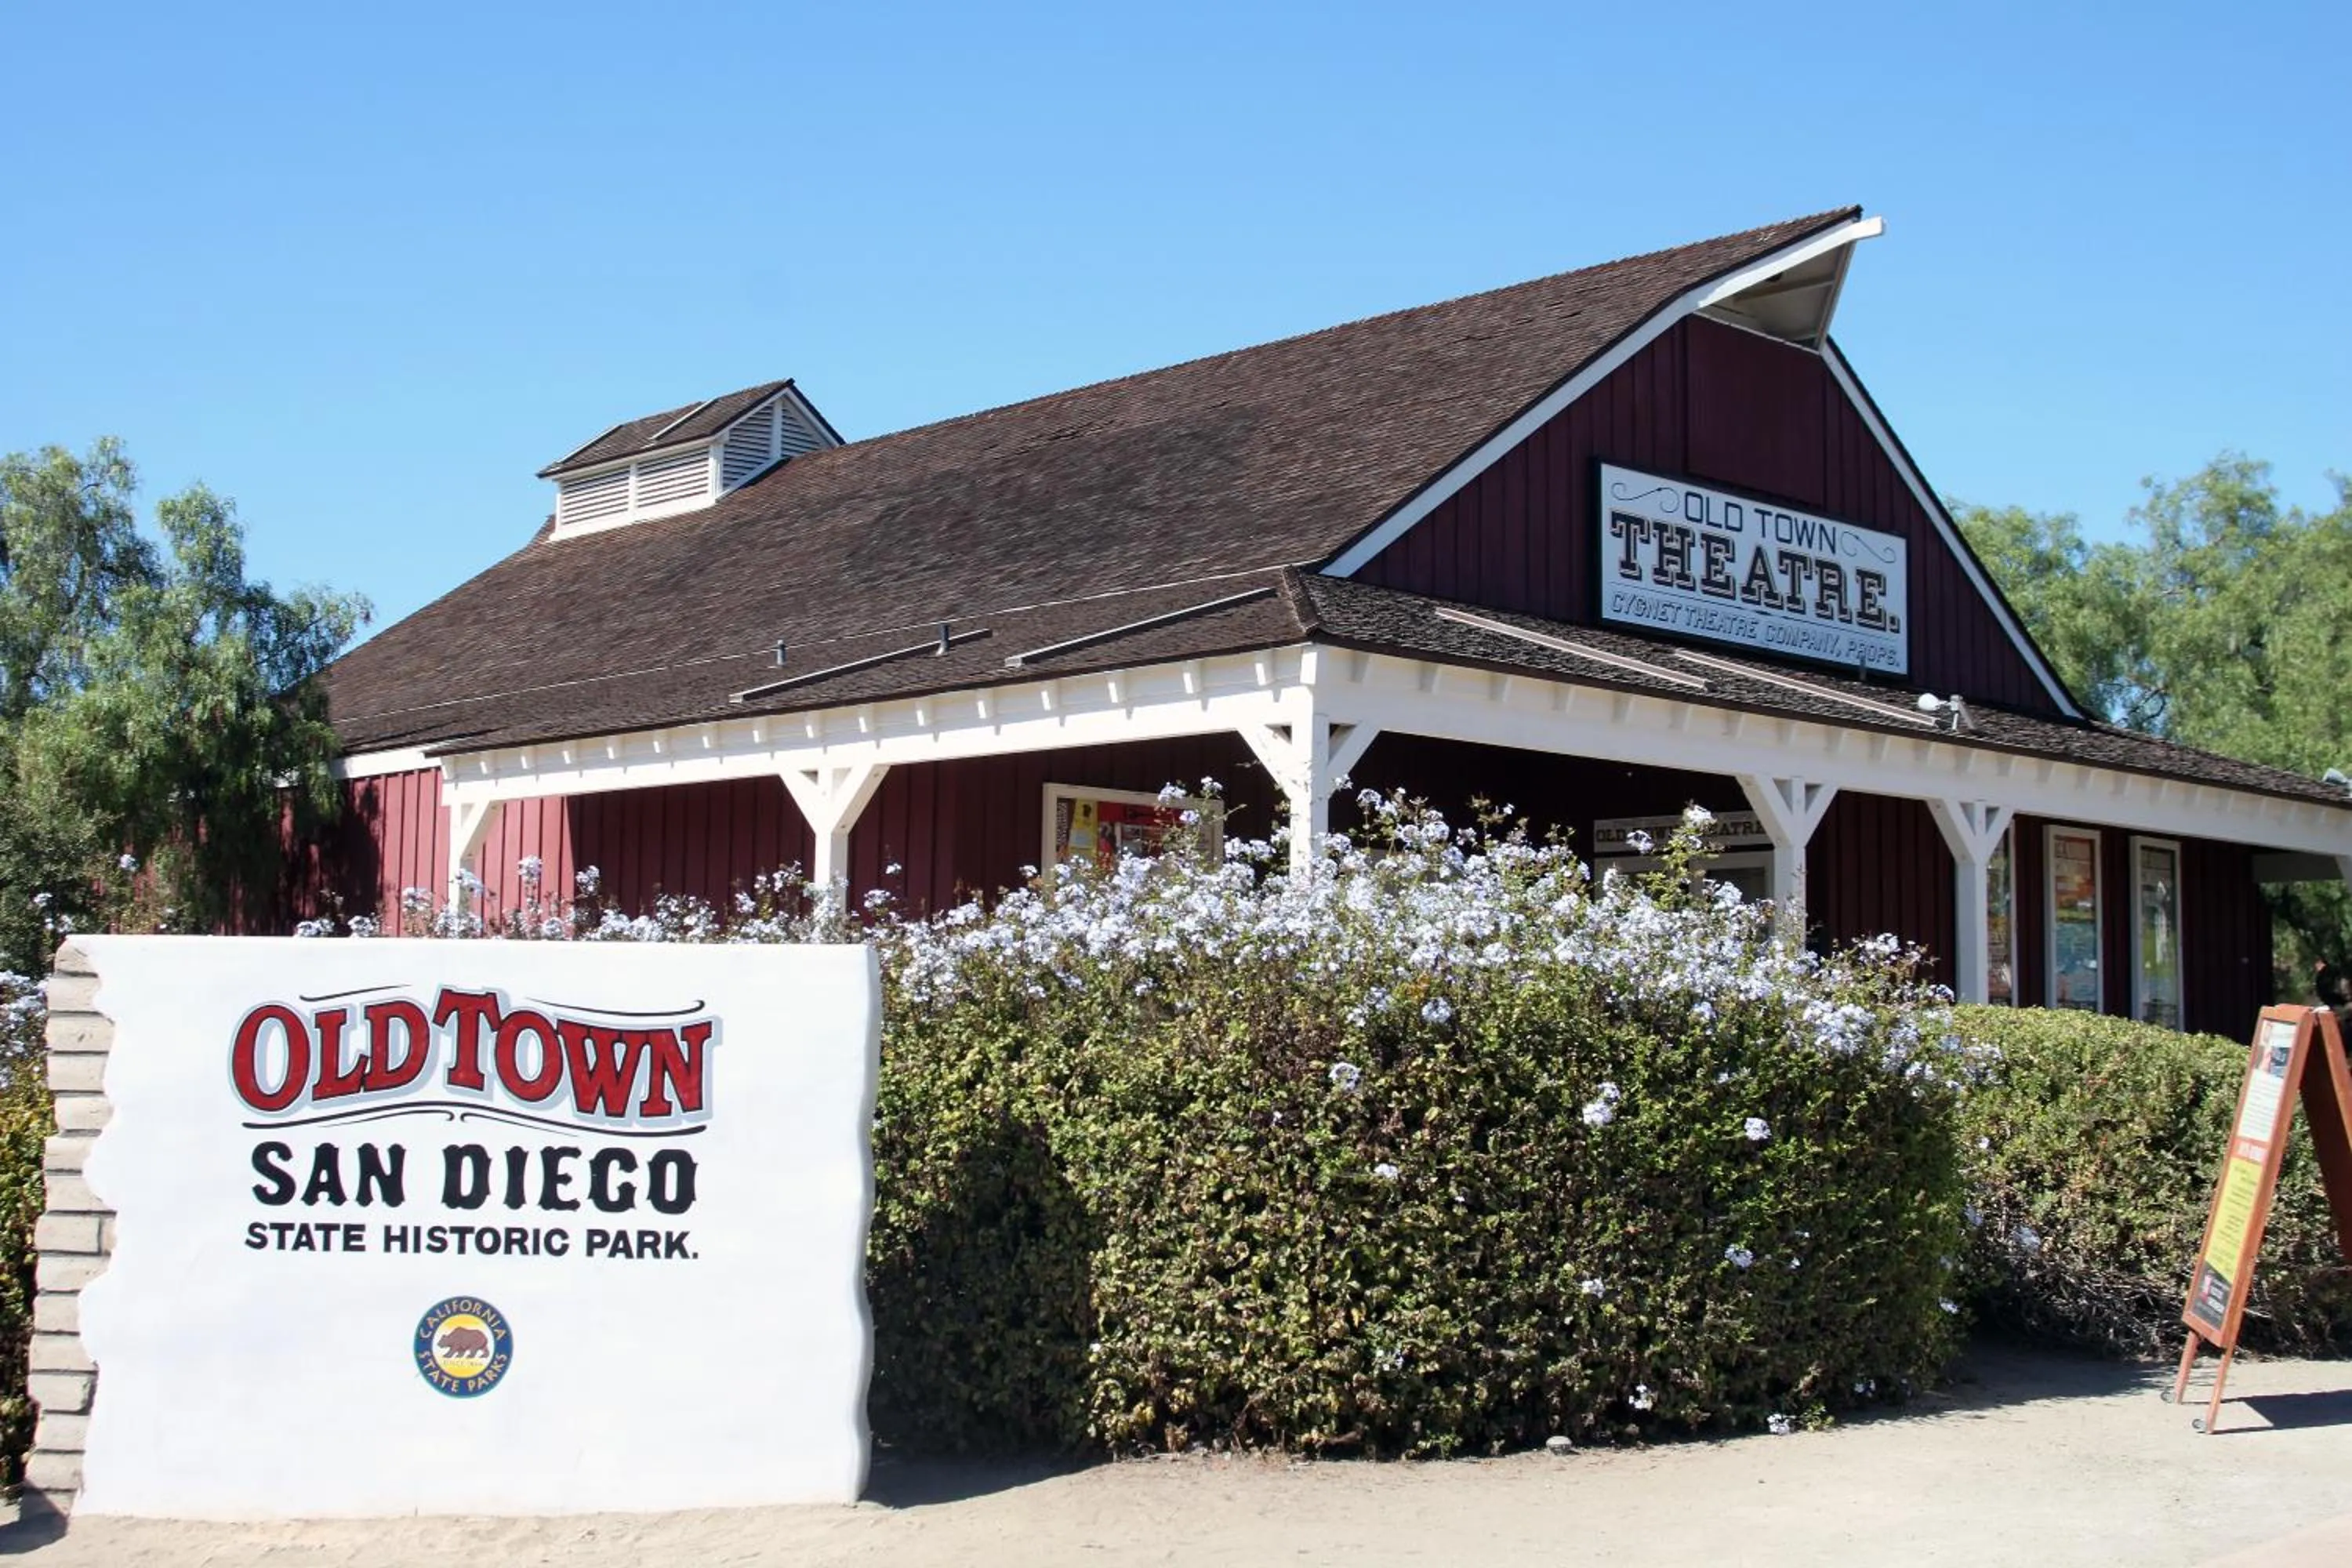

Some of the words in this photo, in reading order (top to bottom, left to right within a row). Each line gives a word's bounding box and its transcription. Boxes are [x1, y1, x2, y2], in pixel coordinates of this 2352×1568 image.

[1684, 491, 1744, 532] OLD
[1754, 507, 1837, 554] TOWN
[1610, 510, 1900, 634] THEATRE.
[1610, 590, 1682, 623] CYGNET
[1686, 600, 1759, 640] THEATRE
[1765, 624, 1842, 658] COMPANY,
[230, 999, 430, 1112] OLD
[431, 987, 713, 1118] TOWN
[250, 1141, 406, 1207] SAN
[440, 1143, 699, 1214] DIEGO
[245, 1221, 367, 1253] STATE
[383, 1224, 571, 1256] HISTORIC
[585, 1228, 700, 1260] PARK.
[419, 1299, 506, 1341] CALIFORNIA
[418, 1350, 460, 1393] STATE
[467, 1353, 508, 1392] PARKS
